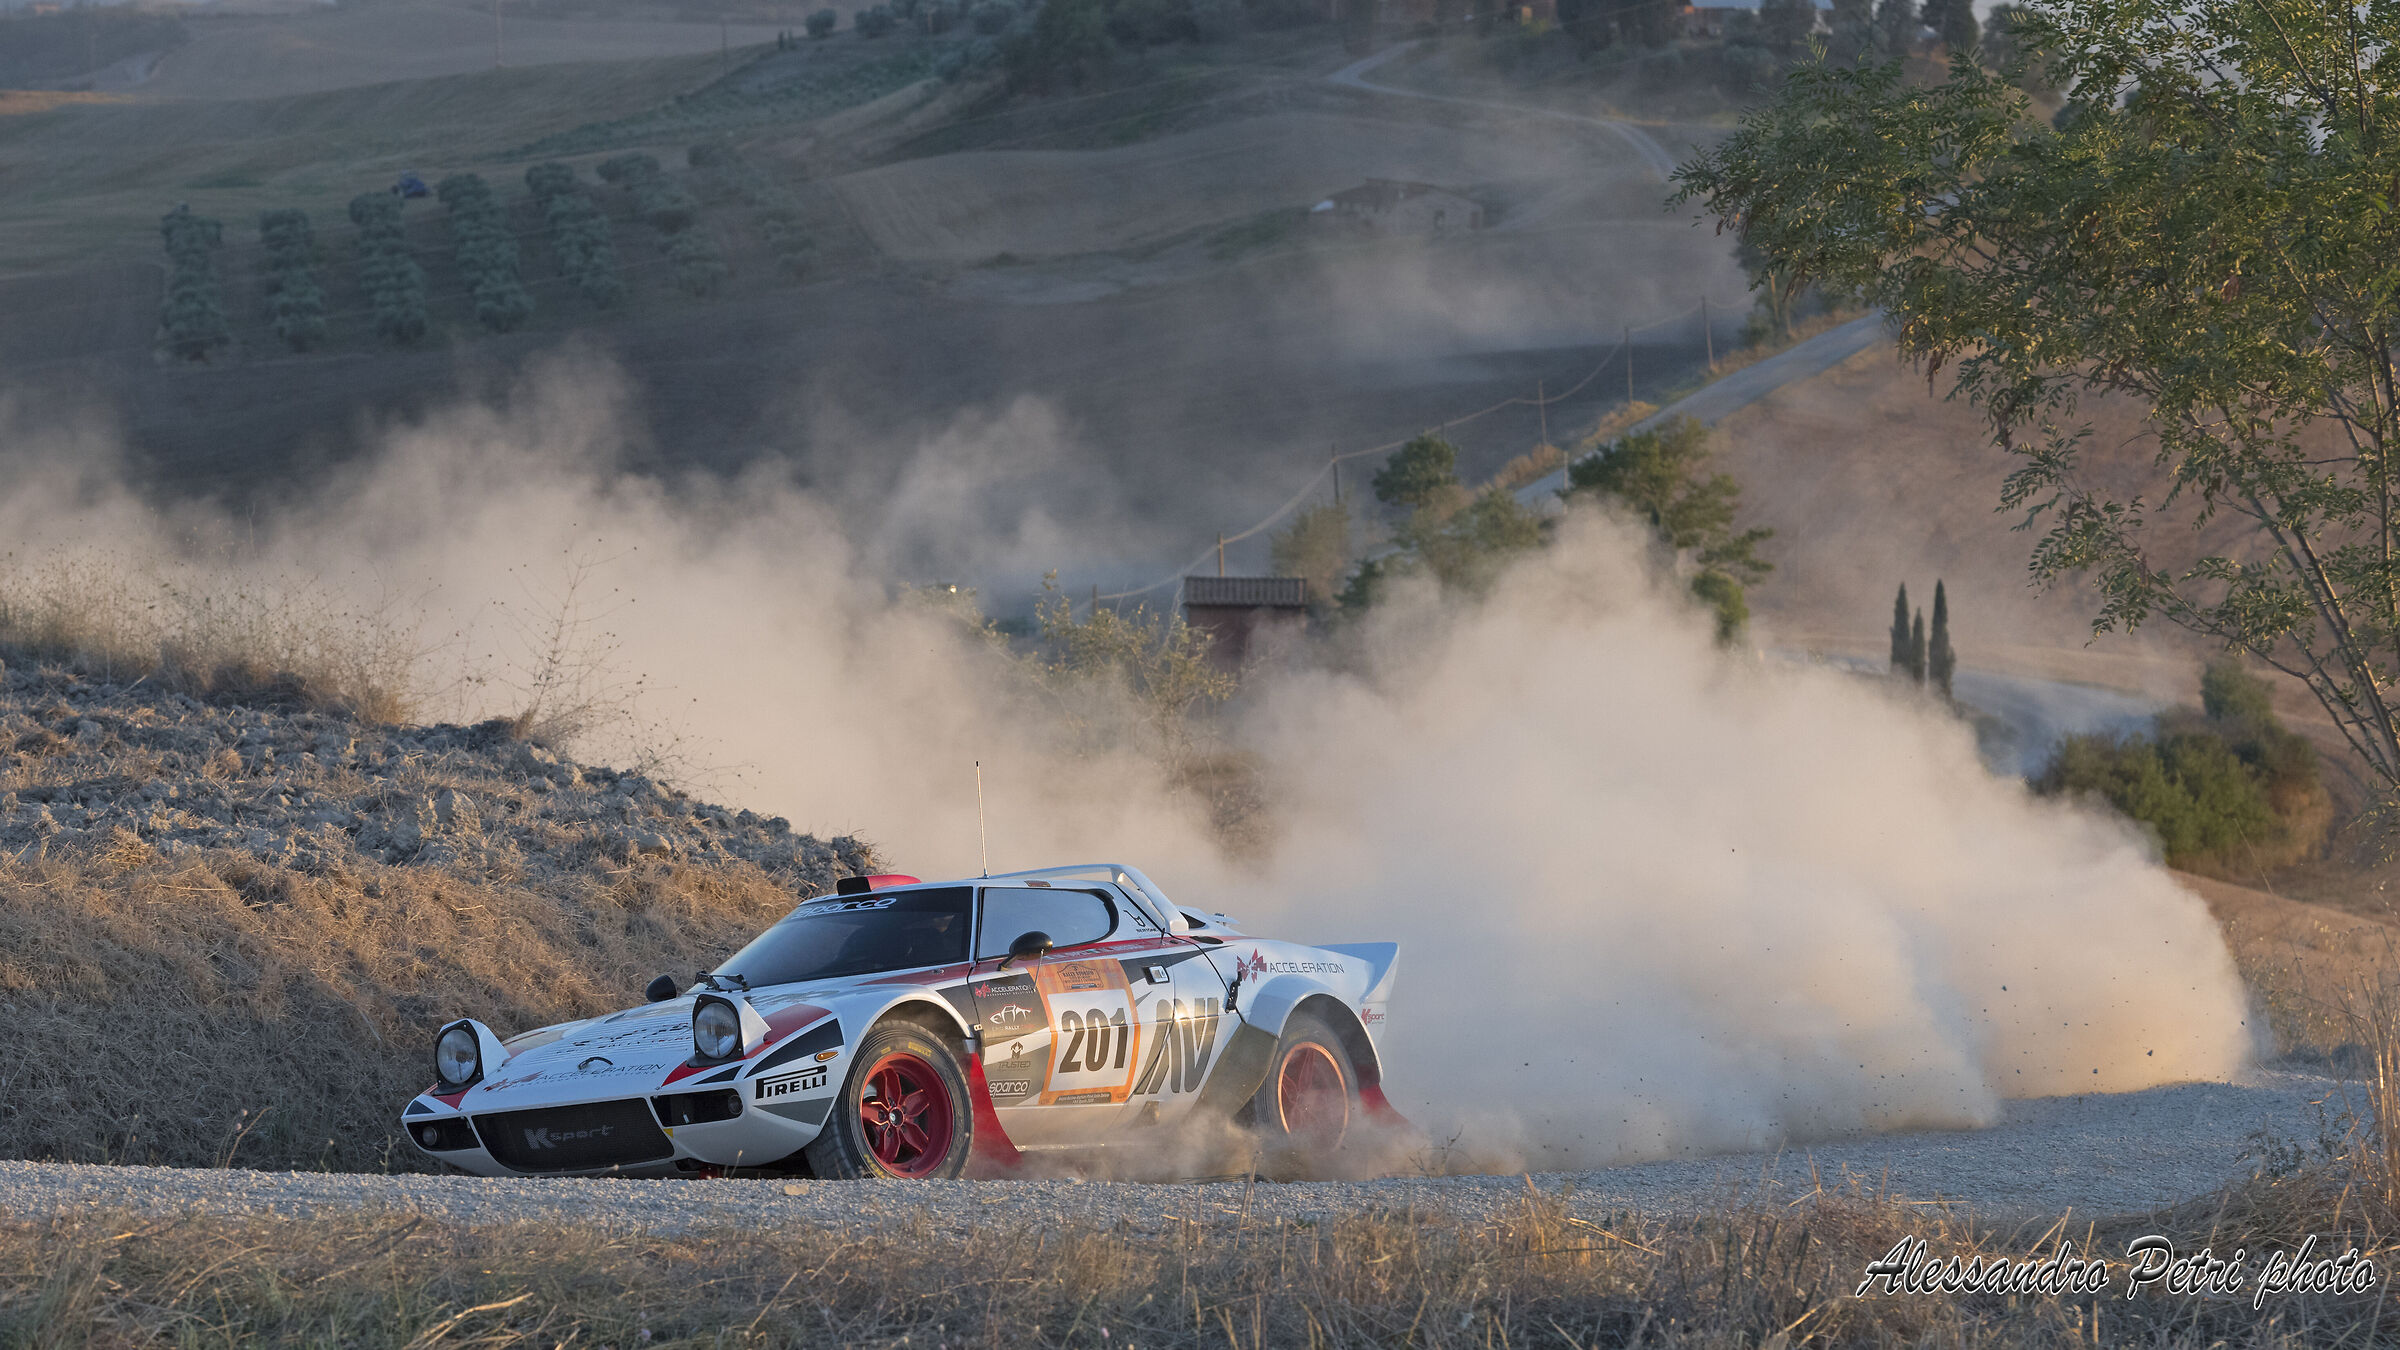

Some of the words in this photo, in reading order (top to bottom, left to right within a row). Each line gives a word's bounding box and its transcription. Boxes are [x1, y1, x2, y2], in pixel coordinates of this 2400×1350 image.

[1269, 962, 1345, 974] ACCELERATION
[1058, 1007, 1129, 1074] 201
[755, 1065, 828, 1099] PIRELLI
[988, 1080, 1029, 1097] sparco
